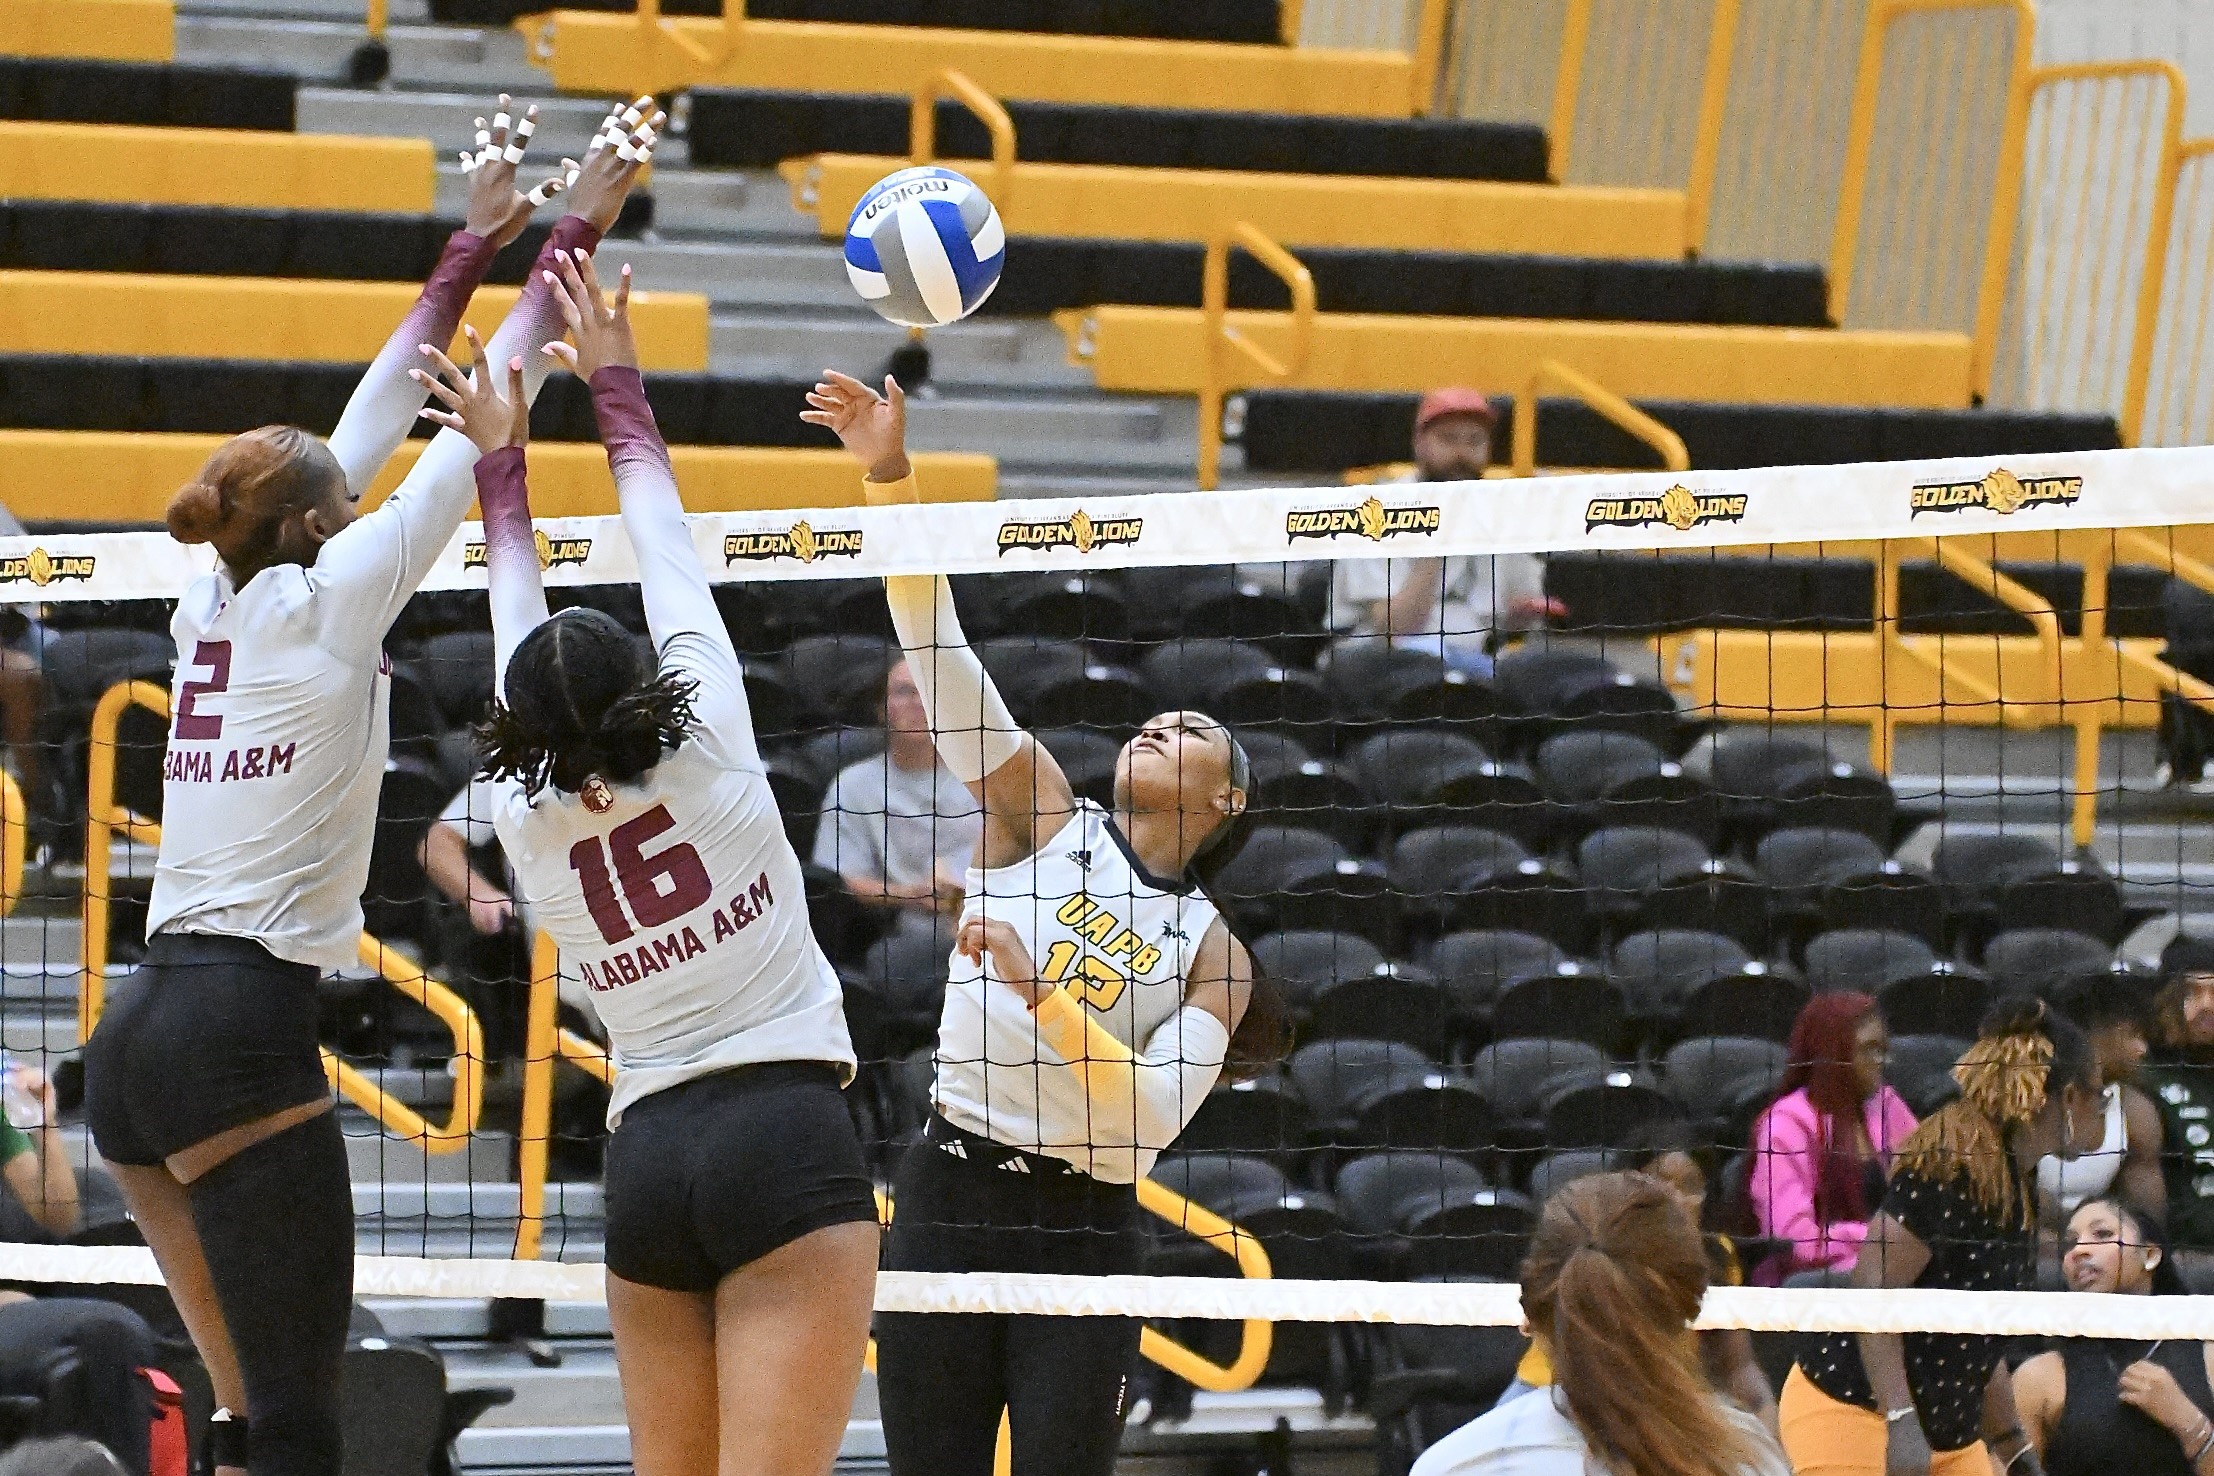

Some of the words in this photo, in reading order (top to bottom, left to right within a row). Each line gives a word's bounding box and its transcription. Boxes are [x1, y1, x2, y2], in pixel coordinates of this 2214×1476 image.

[864, 180, 949, 219] molten
[2025, 479, 2082, 500] LIONS
[1288, 512, 1359, 533] GOLDEN
[1386, 508, 1439, 529] LIONS
[1587, 500, 1664, 520] GOLDEN
[725, 535, 791, 554] GOLDEN
[815, 533, 862, 551] LIONS
[999, 524, 1073, 544] GOLDEN
[1094, 521, 1142, 541] LIONS
[551, 540, 591, 560] LIONS
[51, 558, 94, 576] LIONS
[175, 640, 232, 740] 2
[220, 743, 296, 782] A&M
[570, 803, 713, 945] 16
[713, 871, 774, 944] A&M
[1056, 892, 1161, 975] UAPB
[1041, 940, 1127, 1013] 12
